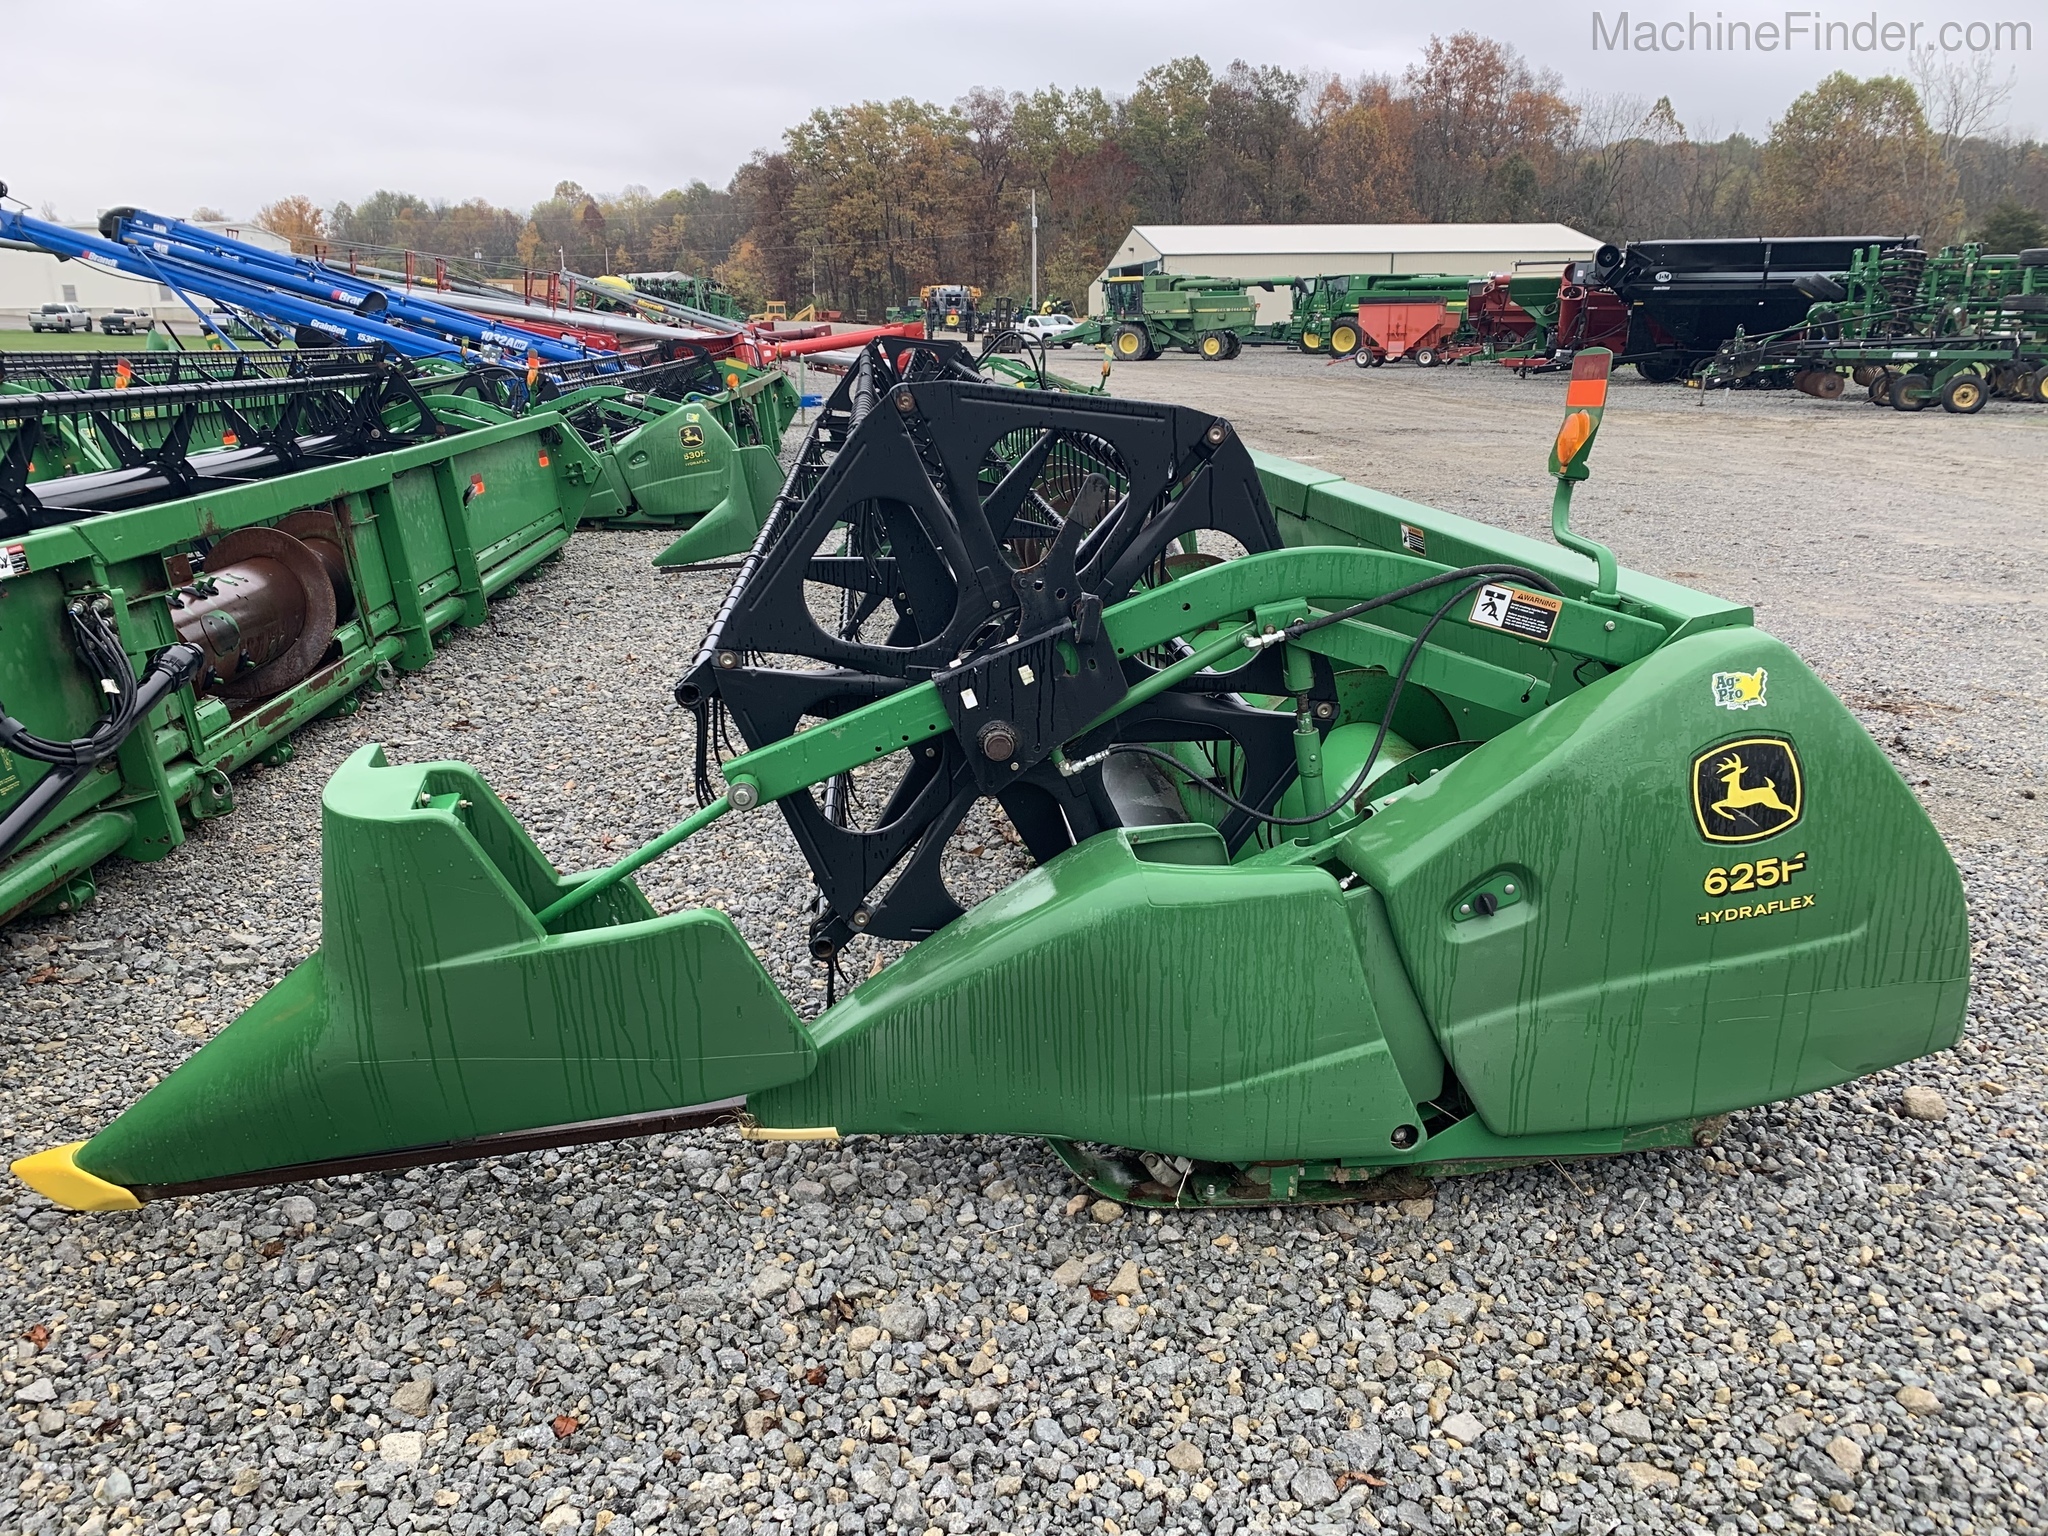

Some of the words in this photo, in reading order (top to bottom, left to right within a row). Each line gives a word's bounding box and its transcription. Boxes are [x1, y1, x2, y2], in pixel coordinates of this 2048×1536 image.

[88, 252, 118, 267] Brandt
[339, 291, 364, 306] Bran
[311, 318, 347, 336] GrainBelt
[481, 331, 514, 347] 1032A
[1524, 594, 1557, 608] WARNING
[1716, 676, 1740, 690] Ag-
[1718, 689, 1743, 702] Pro
[1704, 852, 1807, 897] 625F
[1697, 894, 1816, 925] HYDRAFLEX
